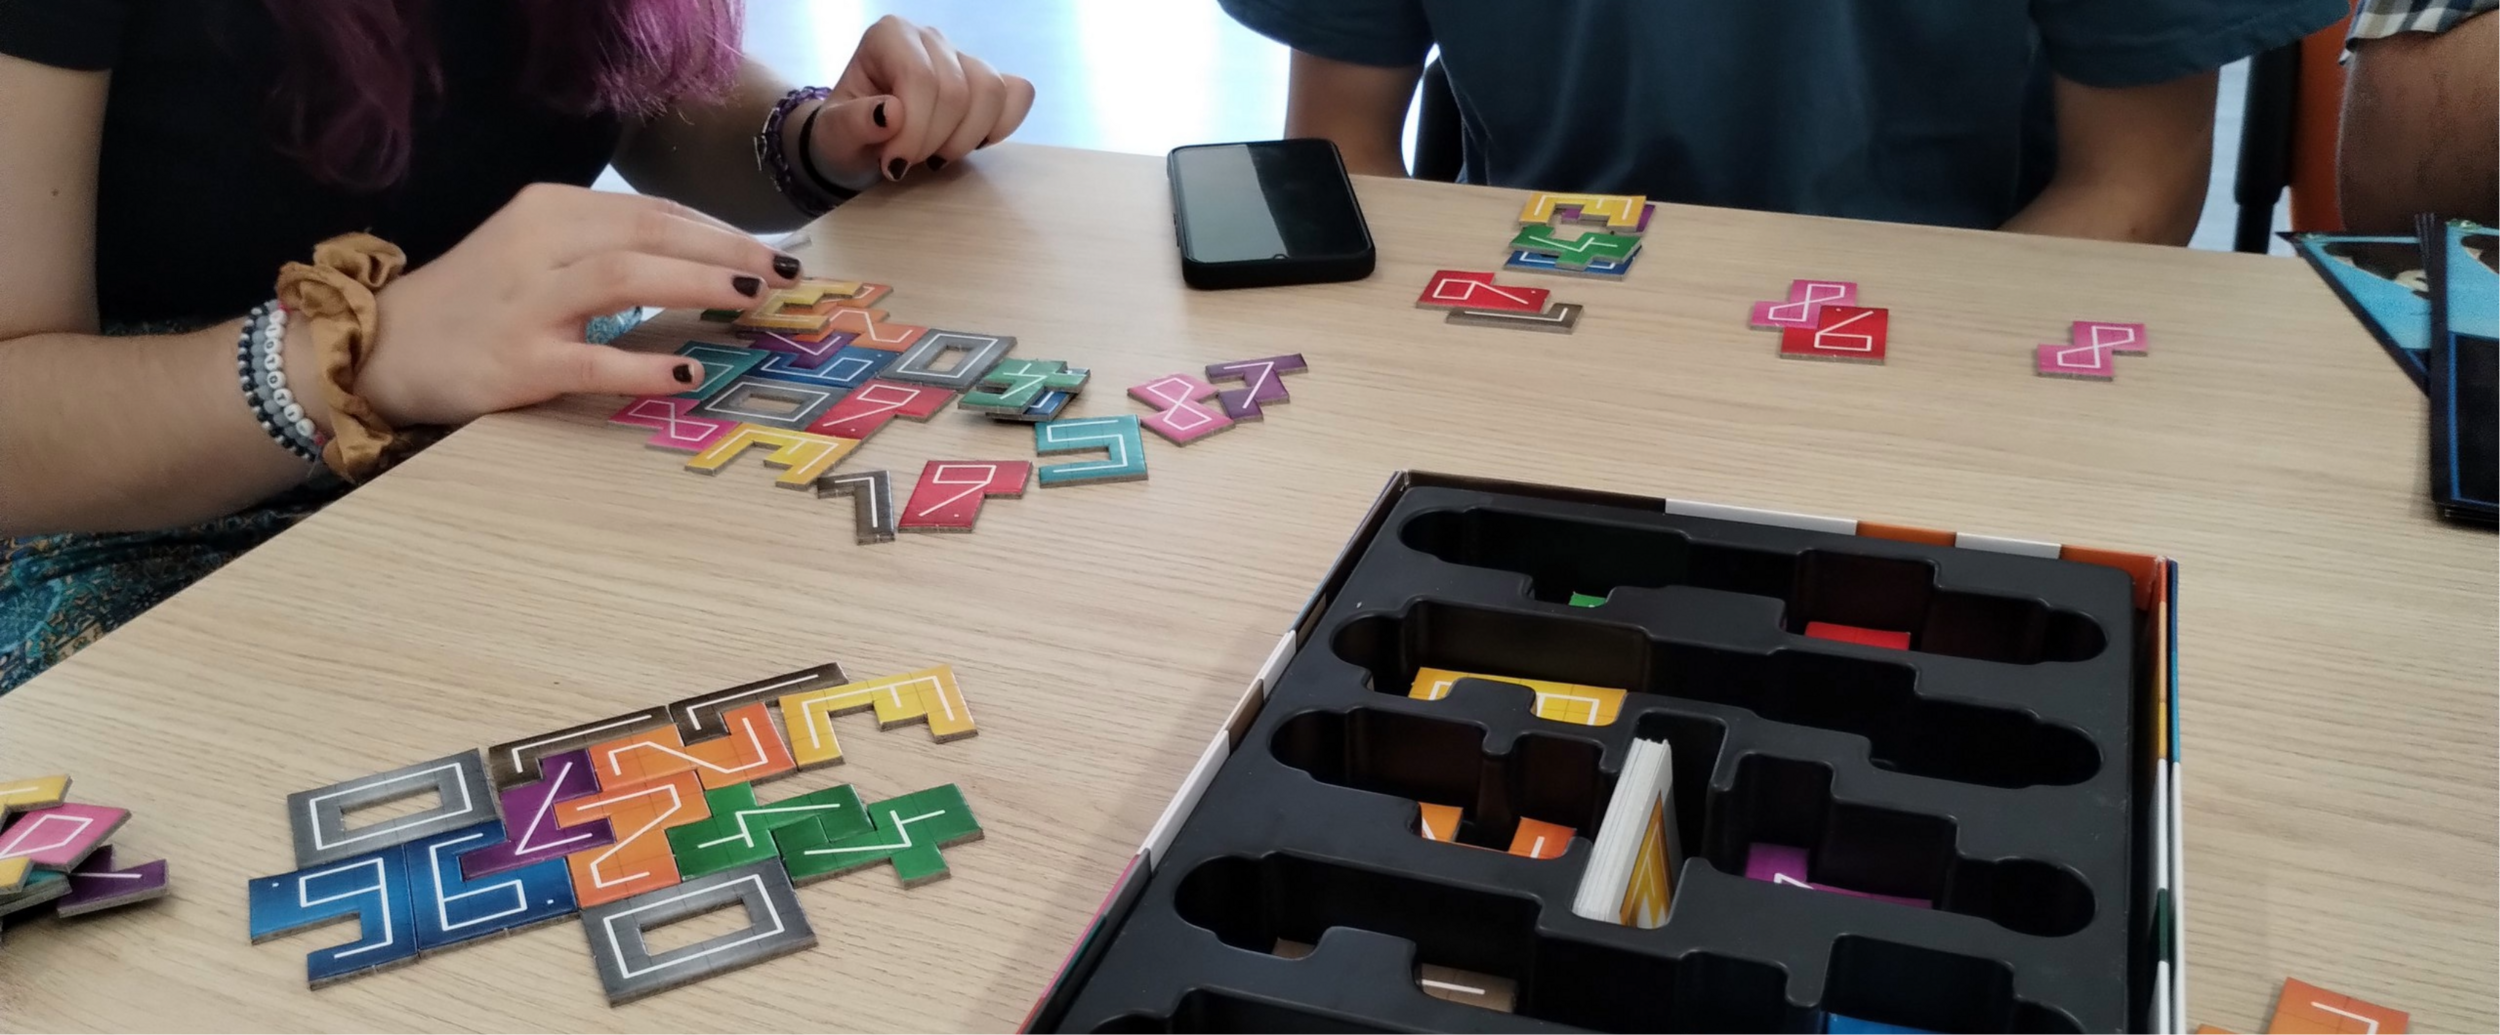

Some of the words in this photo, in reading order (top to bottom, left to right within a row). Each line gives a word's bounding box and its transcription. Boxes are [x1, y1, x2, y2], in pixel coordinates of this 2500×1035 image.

[1768, 283, 1846, 323] 8
[2057, 325, 2136, 370] 8
[627, 399, 720, 442] 8
[1146, 376, 1213, 431] 8
[1046, 418, 1129, 474] 5
[918, 464, 998, 518] 9
[576, 783, 683, 889] 2
[429, 831, 529, 933] 6
